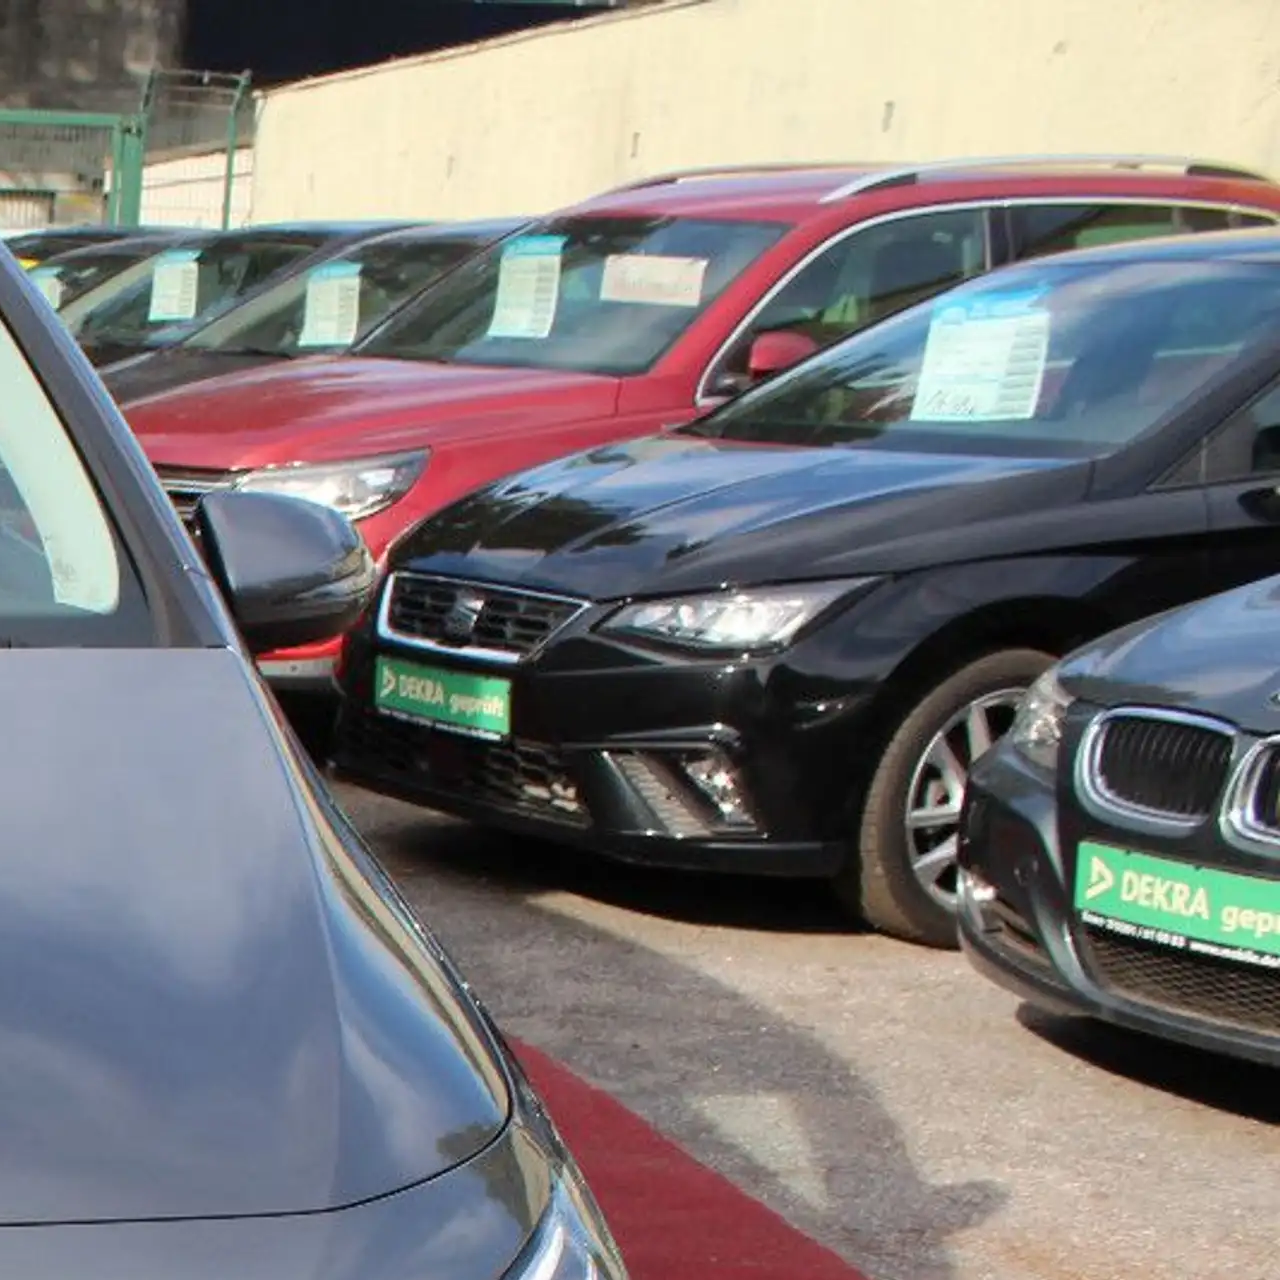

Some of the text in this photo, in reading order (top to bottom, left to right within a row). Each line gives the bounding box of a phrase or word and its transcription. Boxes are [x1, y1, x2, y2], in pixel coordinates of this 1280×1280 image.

[399, 674, 444, 704] DEKRA
[1120, 869, 1280, 938] DEKRA gep
